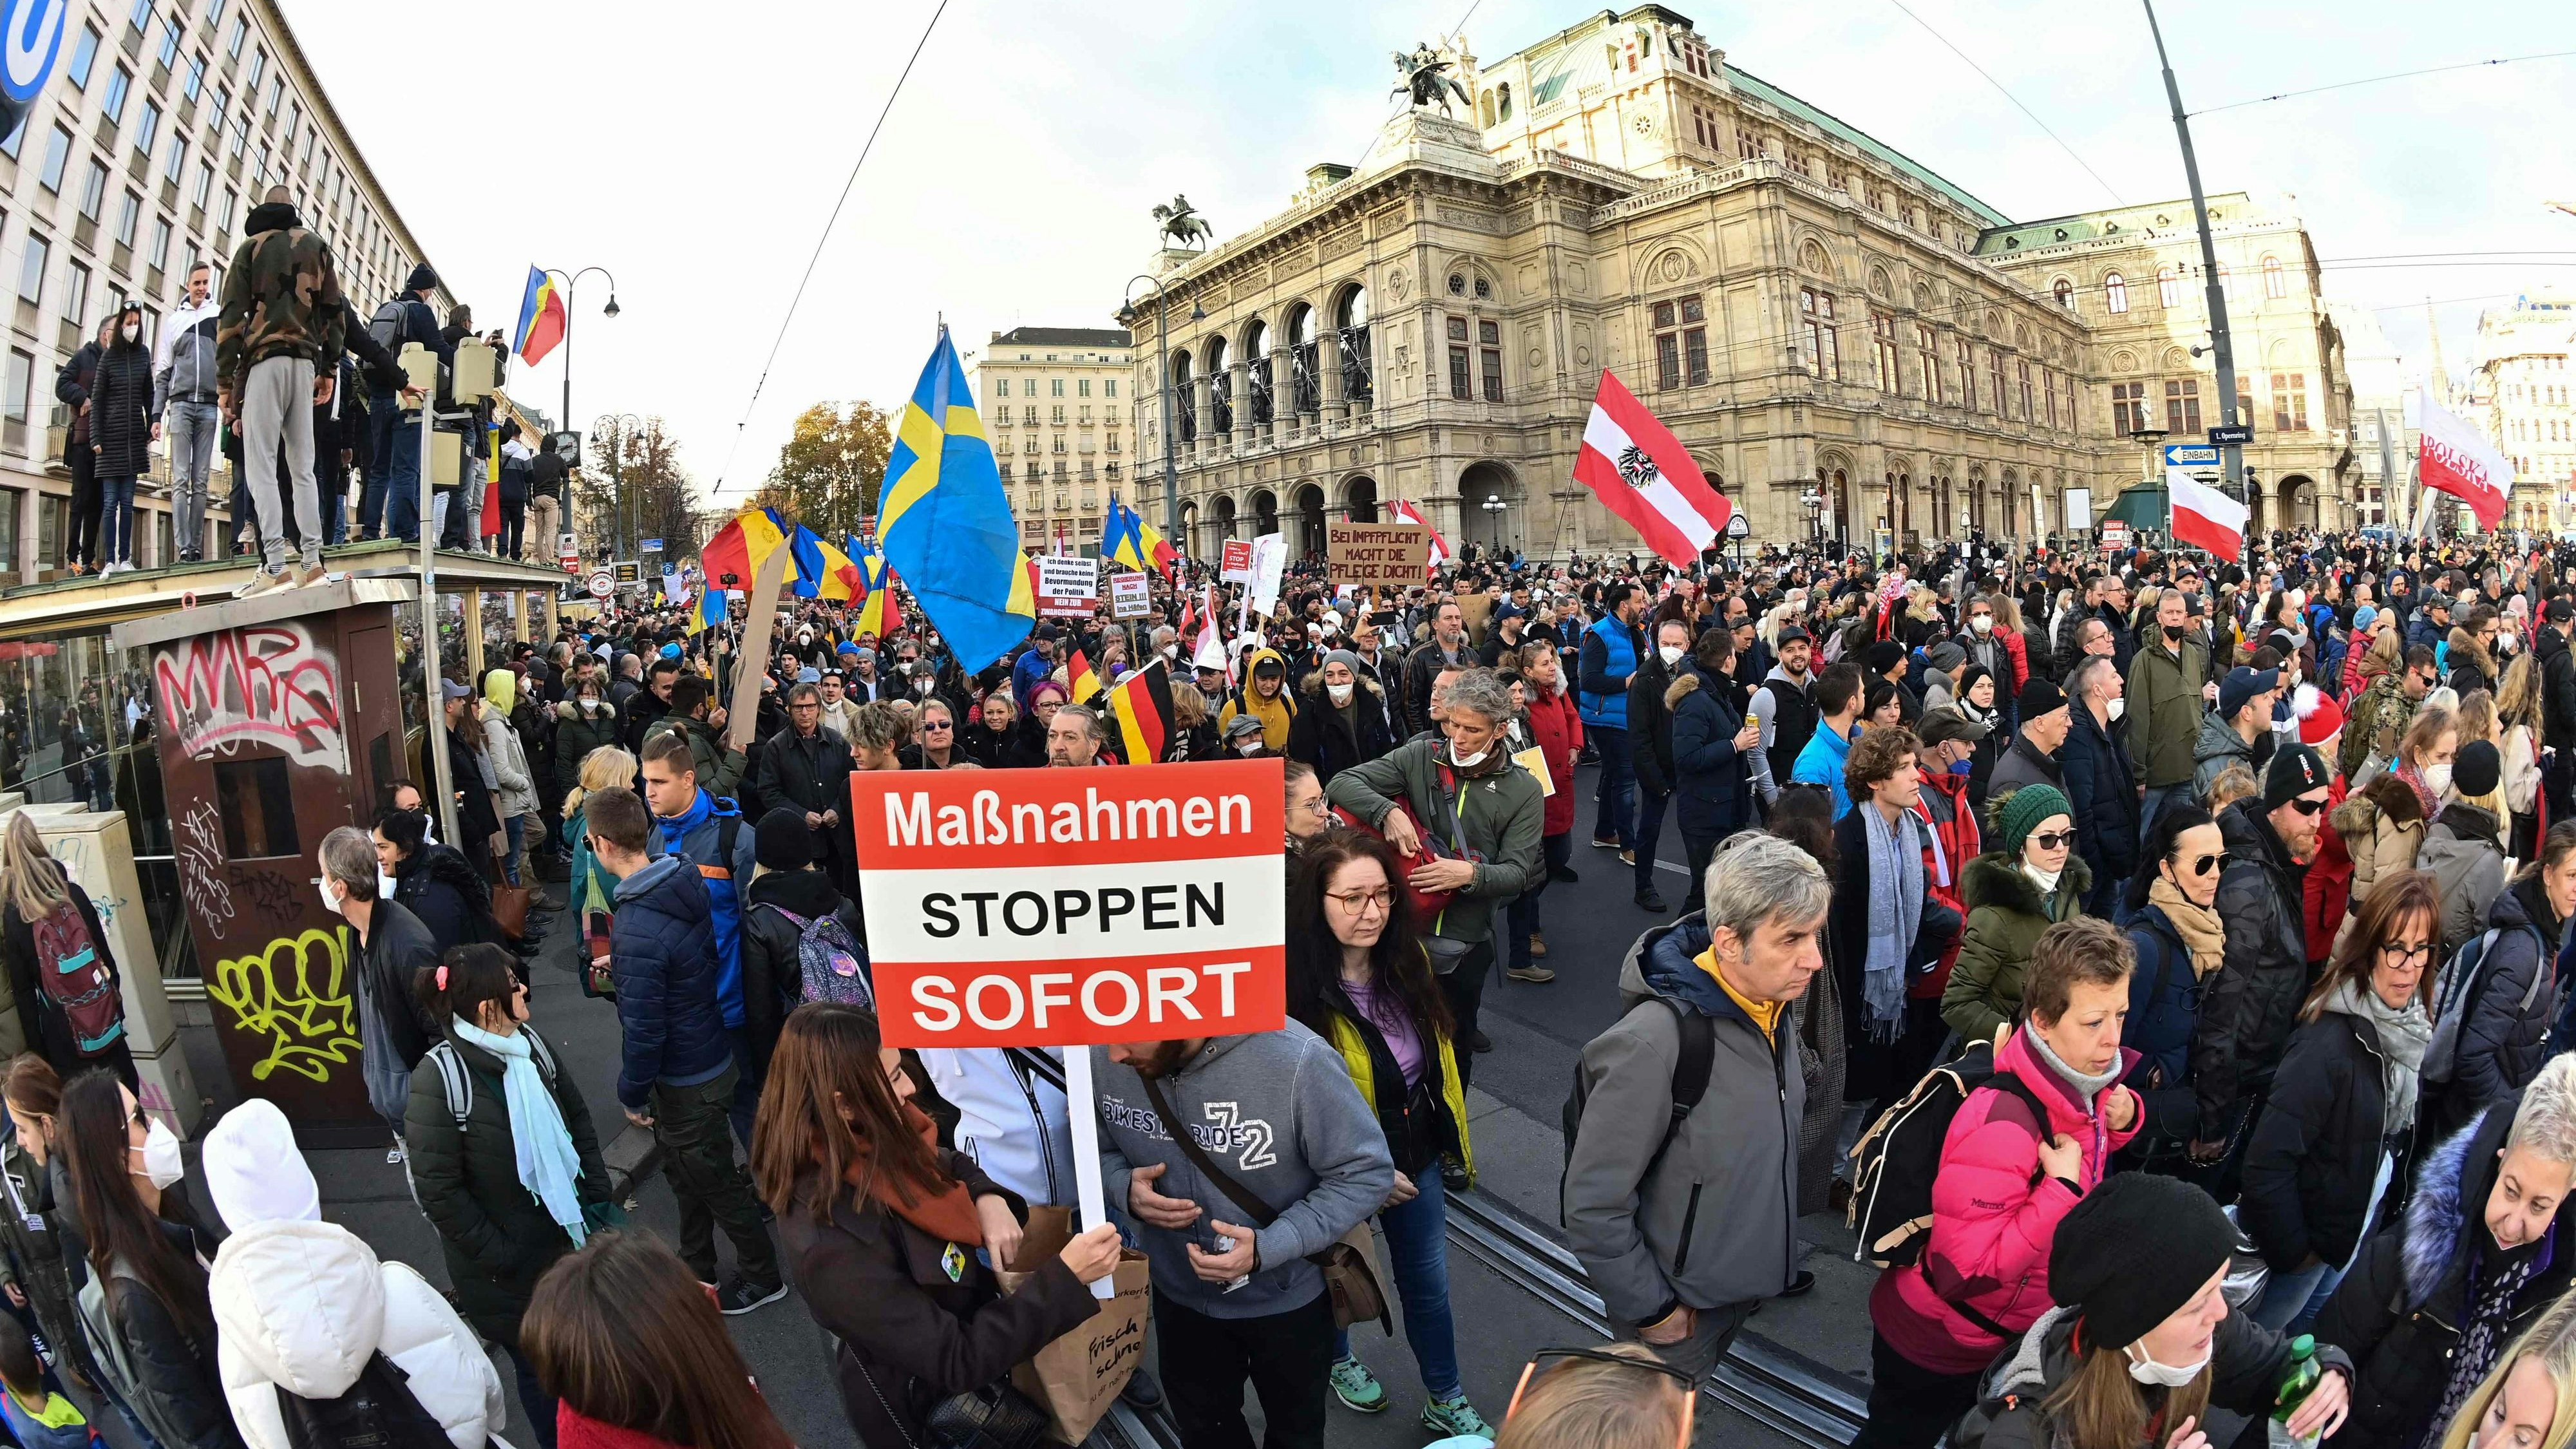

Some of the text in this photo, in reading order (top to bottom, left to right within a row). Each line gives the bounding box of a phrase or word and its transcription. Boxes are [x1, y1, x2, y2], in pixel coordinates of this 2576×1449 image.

[6, 0, 63, 86] U
[2222, 432, 2245, 440] Opernring
[2183, 451, 2213, 459] EINBAHN
[2424, 435, 2488, 493] POLSKA
[1331, 529, 1421, 544] BEI IMPFPFLICHT
[1345, 548, 1406, 561] MACHT DIE
[1113, 574, 1144, 583] REGIERUNG
[1329, 564, 1421, 579] PFLEGE DICHT!
[1045, 578, 1093, 587] Bevormundung
[1115, 594, 1137, 602] STEIN
[1041, 608, 1094, 617] ZWANGSIMPFUNG!!
[884, 787, 1251, 847] Maßnahmen
[922, 882, 1224, 938] STOPPEN
[911, 961, 1251, 1031] SOFORT
[1103, 1101, 1156, 1133] BIKES
[1190, 1122, 1245, 1148] RIDE
[1108, 1287, 1143, 1301] urkerl
